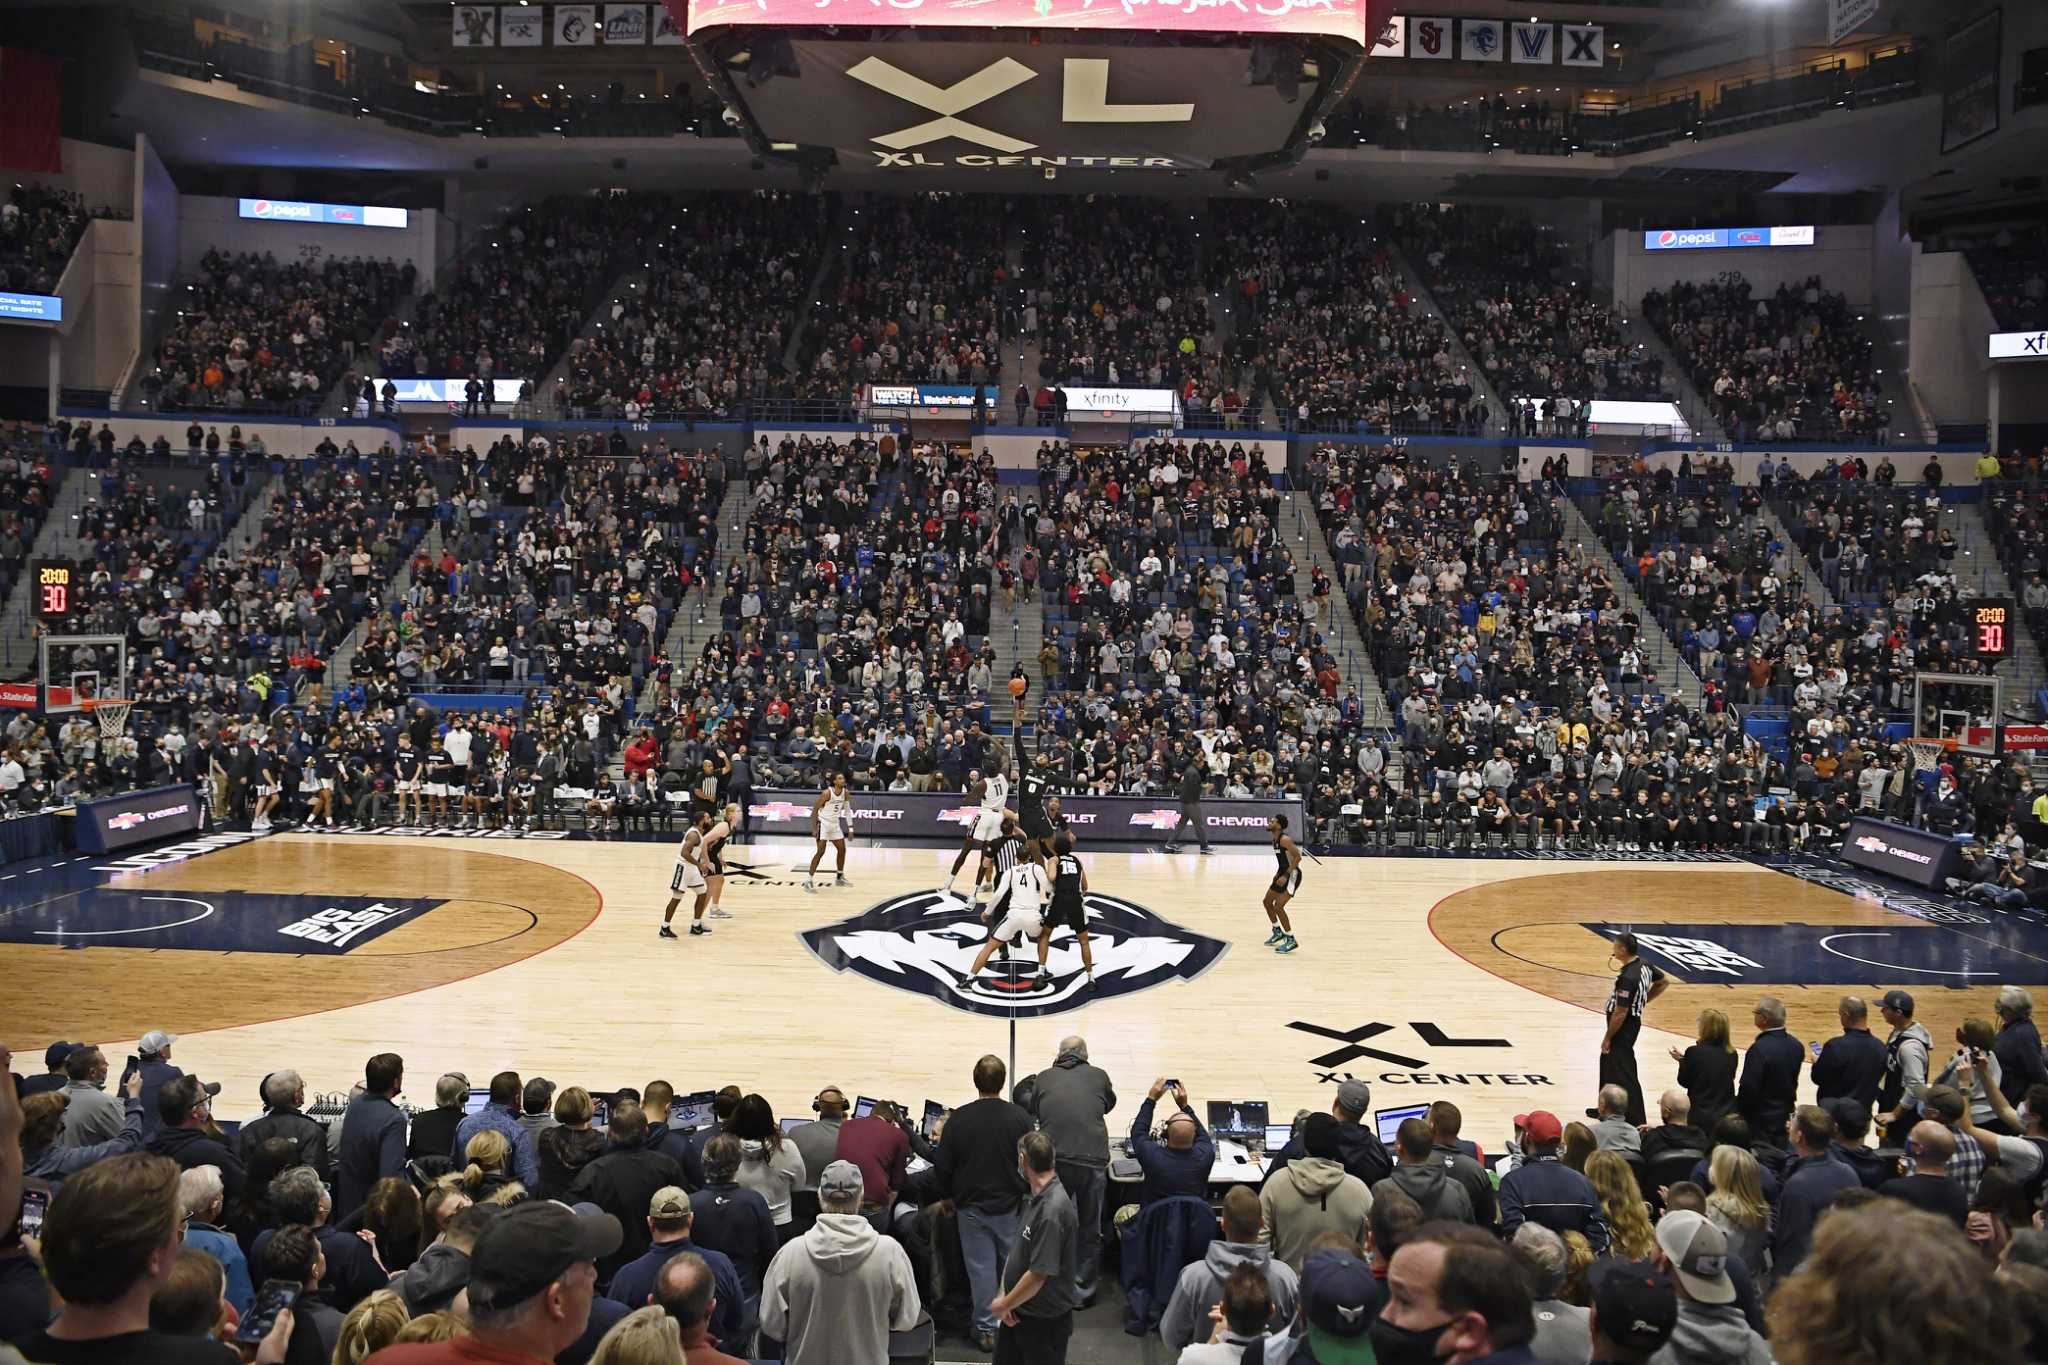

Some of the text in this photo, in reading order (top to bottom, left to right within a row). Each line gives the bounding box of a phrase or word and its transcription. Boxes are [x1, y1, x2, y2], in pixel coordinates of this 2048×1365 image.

[1567, 30, 1598, 60] X
[845, 56, 1195, 153] XL
[872, 151, 1174, 167] XL CENTER
[273, 205, 311, 217] pepsi
[1678, 231, 1716, 246] pepsi
[299, 244, 321, 256] 212
[1718, 271, 1741, 283] 219
[876, 390, 912, 399] WATCH
[1084, 392, 1130, 408] xfinity
[319, 418, 336, 426] 113
[873, 424, 890, 432] 115
[1156, 429, 1174, 437] 116
[1392, 437, 1408, 446] 117
[1716, 443, 1733, 452] 118
[40, 568, 69, 584] 20:00
[43, 586, 66, 612] 30
[1976, 608, 2005, 623] 20:00
[1977, 625, 2002, 651] 30
[994, 783, 1003, 797] 11
[1028, 783, 1037, 794] 0
[833, 804, 839, 813] 5
[1206, 816, 1270, 827] CHEVROL
[1060, 861, 1078, 875] 15
[1019, 873, 1028, 888] 4
[277, 907, 353, 938] BIG
[303, 902, 400, 944] EAST
[1670, 936, 1765, 969] BIG
[1284, 1021, 1514, 1069] XL
[1313, 1073, 1555, 1085] XL CENTER
